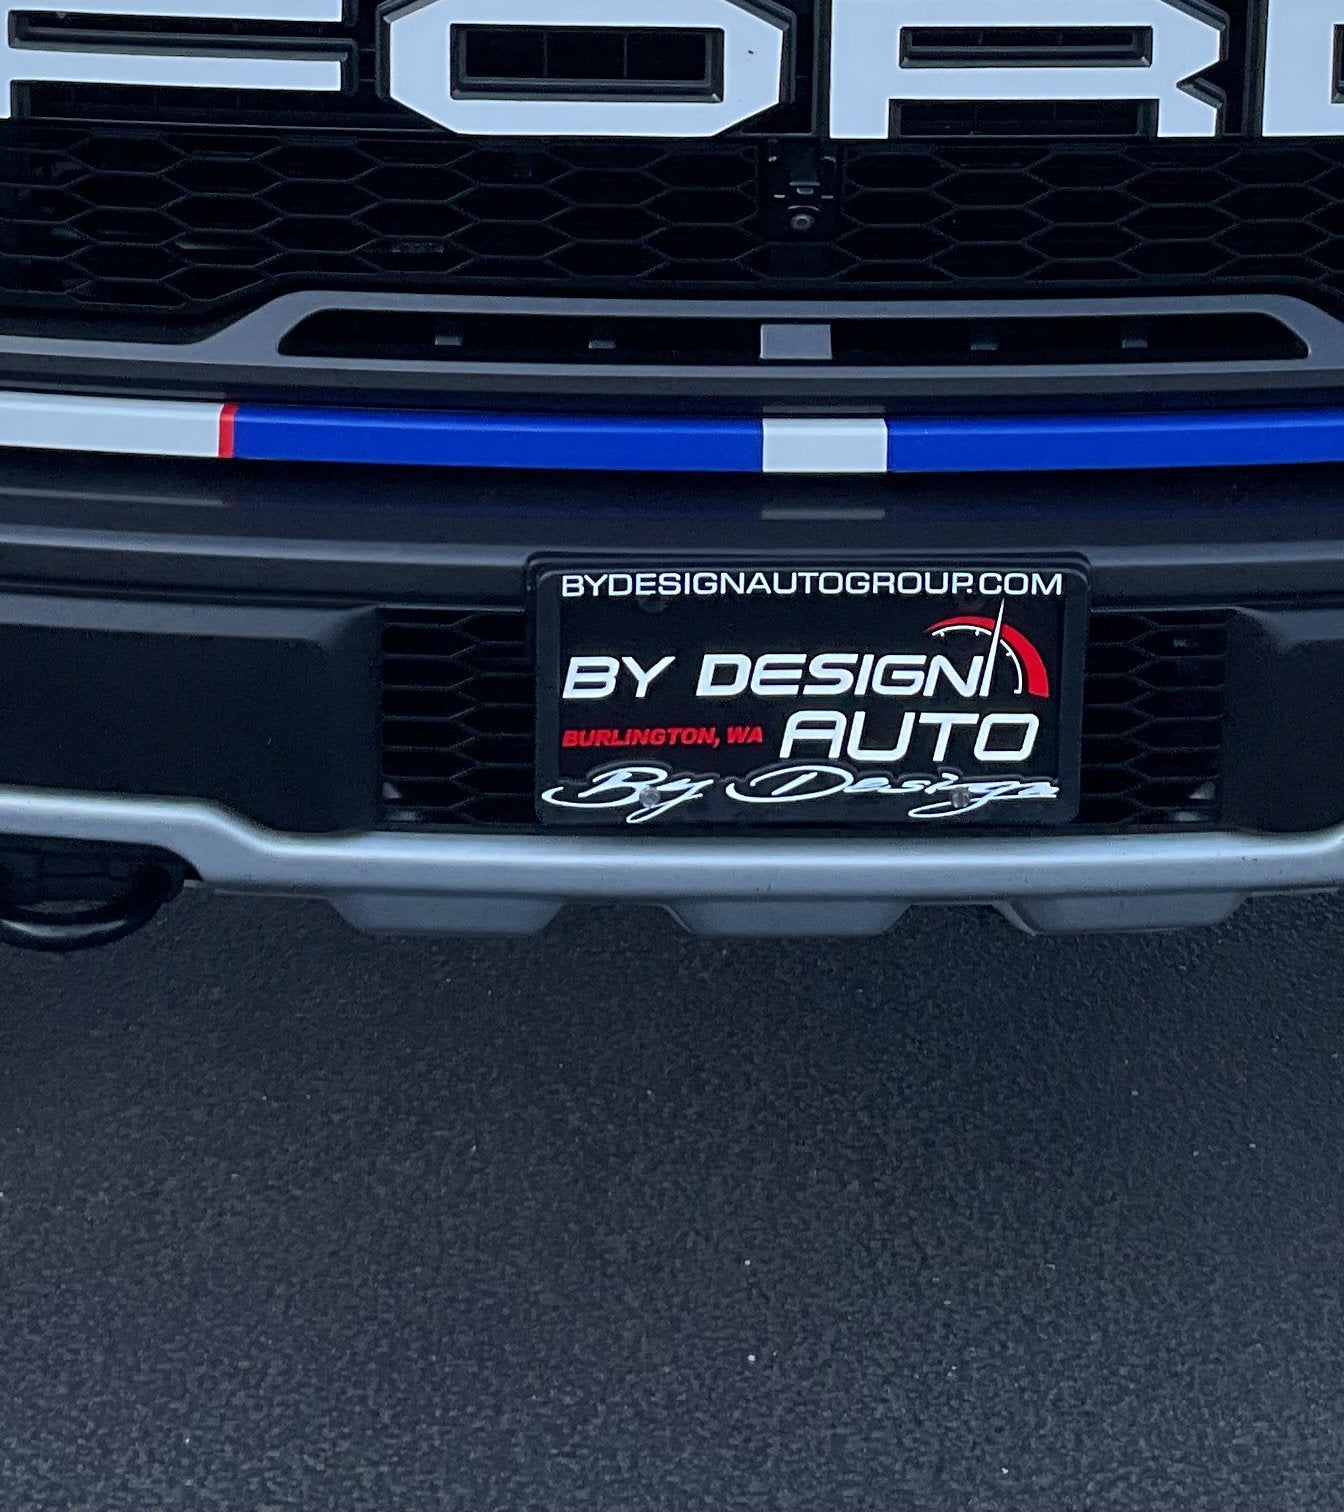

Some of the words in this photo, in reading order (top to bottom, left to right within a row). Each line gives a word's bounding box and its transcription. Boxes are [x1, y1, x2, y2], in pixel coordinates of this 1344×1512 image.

[561, 571, 1063, 598] BYDESIGNAUTOGROUP.COM
[562, 656, 676, 700] BY
[695, 653, 985, 698] DESIGN
[561, 726, 721, 749] BURLINGTON,
[726, 726, 764, 746] WA
[778, 710, 1041, 763] AUTO
[541, 766, 716, 824] By
[725, 765, 1060, 820] Design
